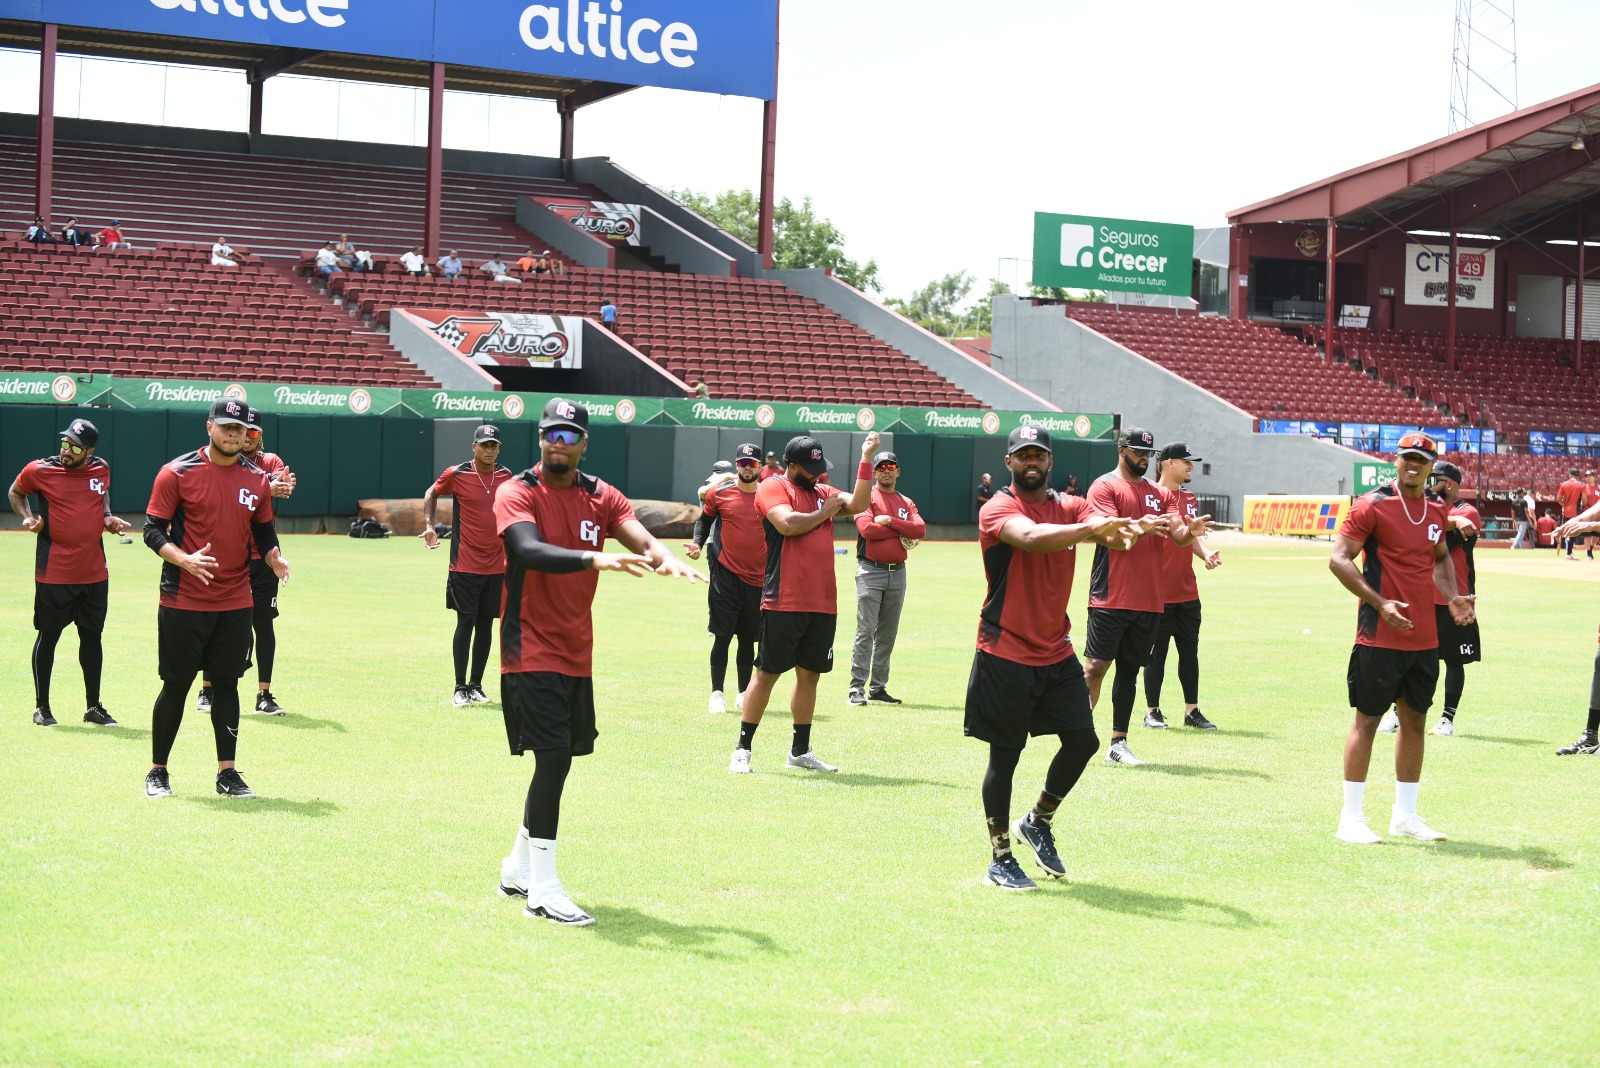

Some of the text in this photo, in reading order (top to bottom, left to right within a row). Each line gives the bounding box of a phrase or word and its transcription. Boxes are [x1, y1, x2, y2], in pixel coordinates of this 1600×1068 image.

[518, 0, 698, 68] altice
[1100, 225, 1159, 249] Seguros
[1098, 246, 1168, 273] Crecer
[1460, 254, 1483, 263] CANAL
[1463, 262, 1481, 276] 49
[1098, 272, 1167, 287] Aliados por tu futuro
[453, 320, 569, 358] TAURO
[145, 381, 222, 402] Presidente
[273, 386, 348, 406] Presidente
[226, 401, 240, 416] GC
[432, 391, 501, 412] Presidente
[556, 401, 575, 420] GC
[692, 402, 754, 421] Presidente
[796, 406, 856, 424] Presidente
[925, 410, 981, 429] Presidente
[1019, 413, 1074, 432] Presidente
[1377, 465, 1398, 477] Segur
[1377, 475, 1396, 486] Cre
[90, 478, 105, 495] GC
[238, 488, 259, 511] GC
[1145, 494, 1161, 512] GC
[1265, 503, 1317, 529] MOTORS
[1459, 643, 1474, 655] GC
